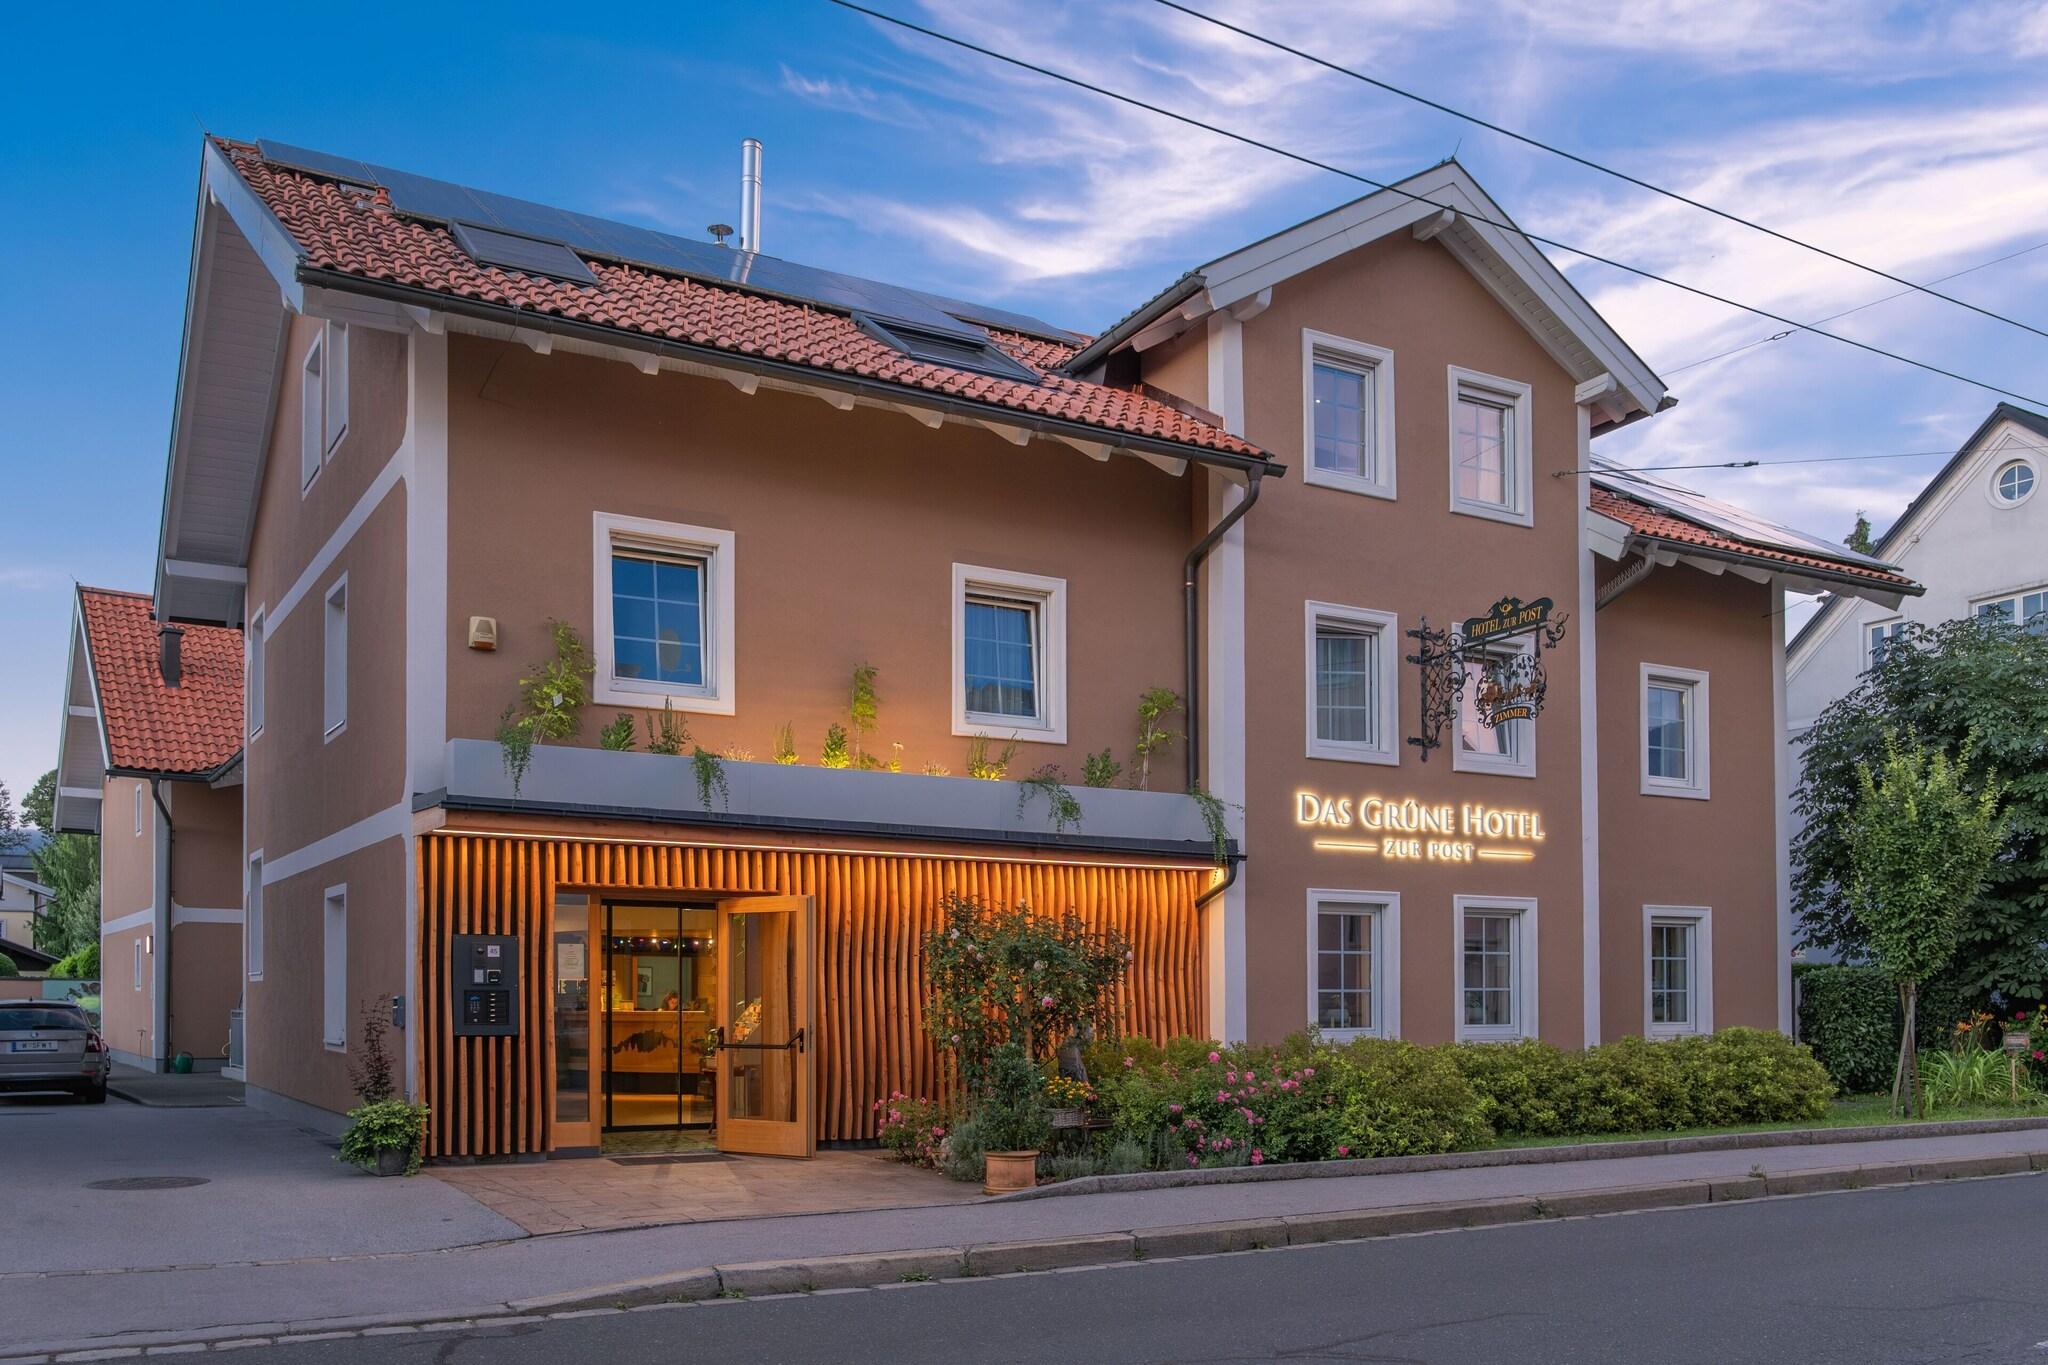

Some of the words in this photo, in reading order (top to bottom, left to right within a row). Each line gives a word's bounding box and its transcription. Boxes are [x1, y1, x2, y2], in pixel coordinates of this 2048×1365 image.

[1471, 618, 1501, 638] HOTEL
[1519, 606, 1543, 624] POST
[1495, 707, 1528, 723] ZIMMER
[1385, 839, 1422, 857] ZUR
[1430, 842, 1475, 861] POST
